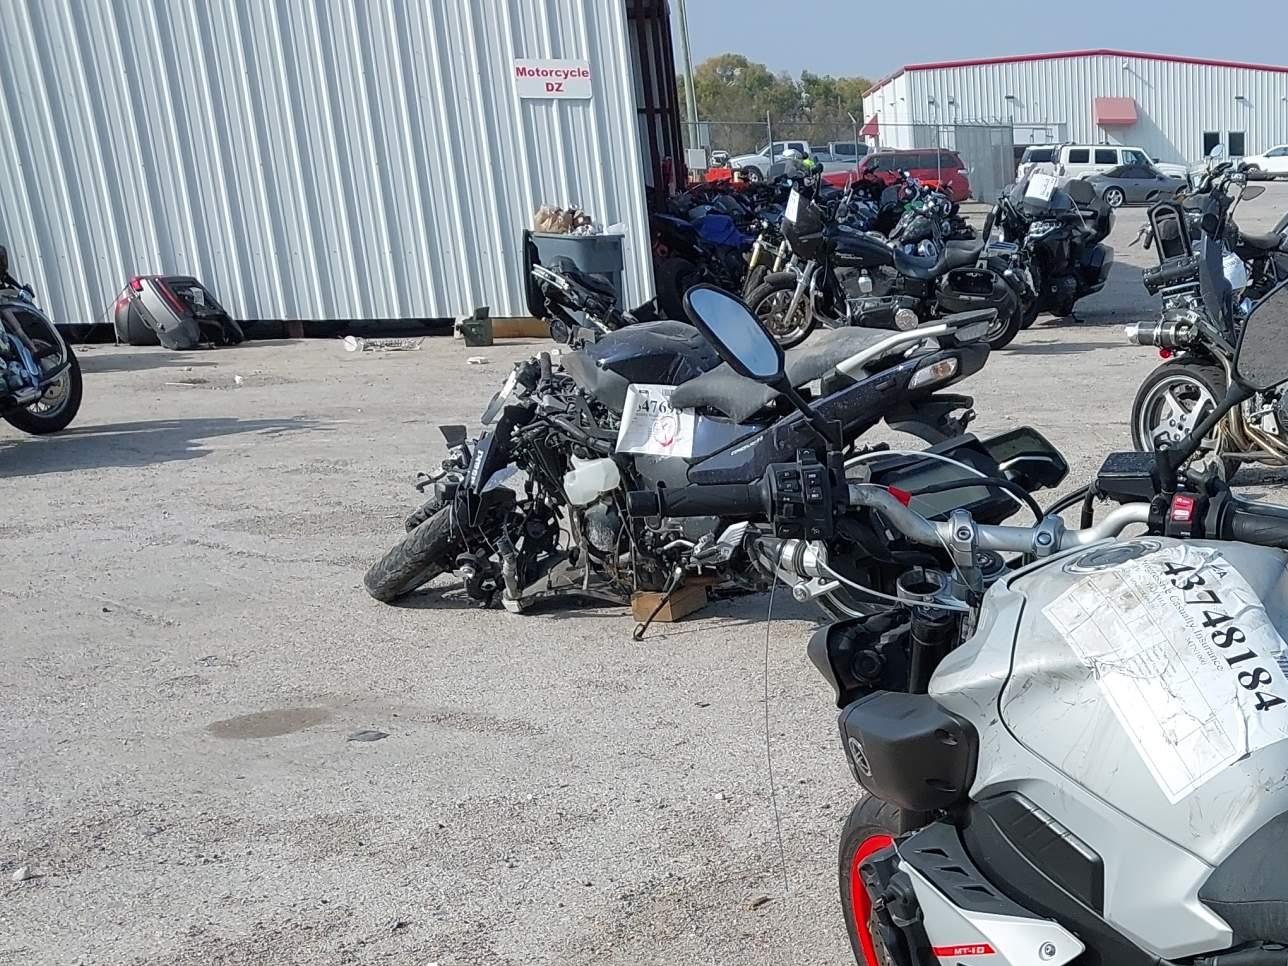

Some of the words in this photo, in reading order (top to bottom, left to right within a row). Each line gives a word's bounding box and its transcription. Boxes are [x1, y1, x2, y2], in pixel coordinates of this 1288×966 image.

[515, 67, 589, 79] Motorcycle
[545, 82, 564, 92] DZ
[1163, 562, 1287, 712] 43748184
[1194, 628, 1224, 671] Insurance
[954, 946, 984, 955] MT-10
